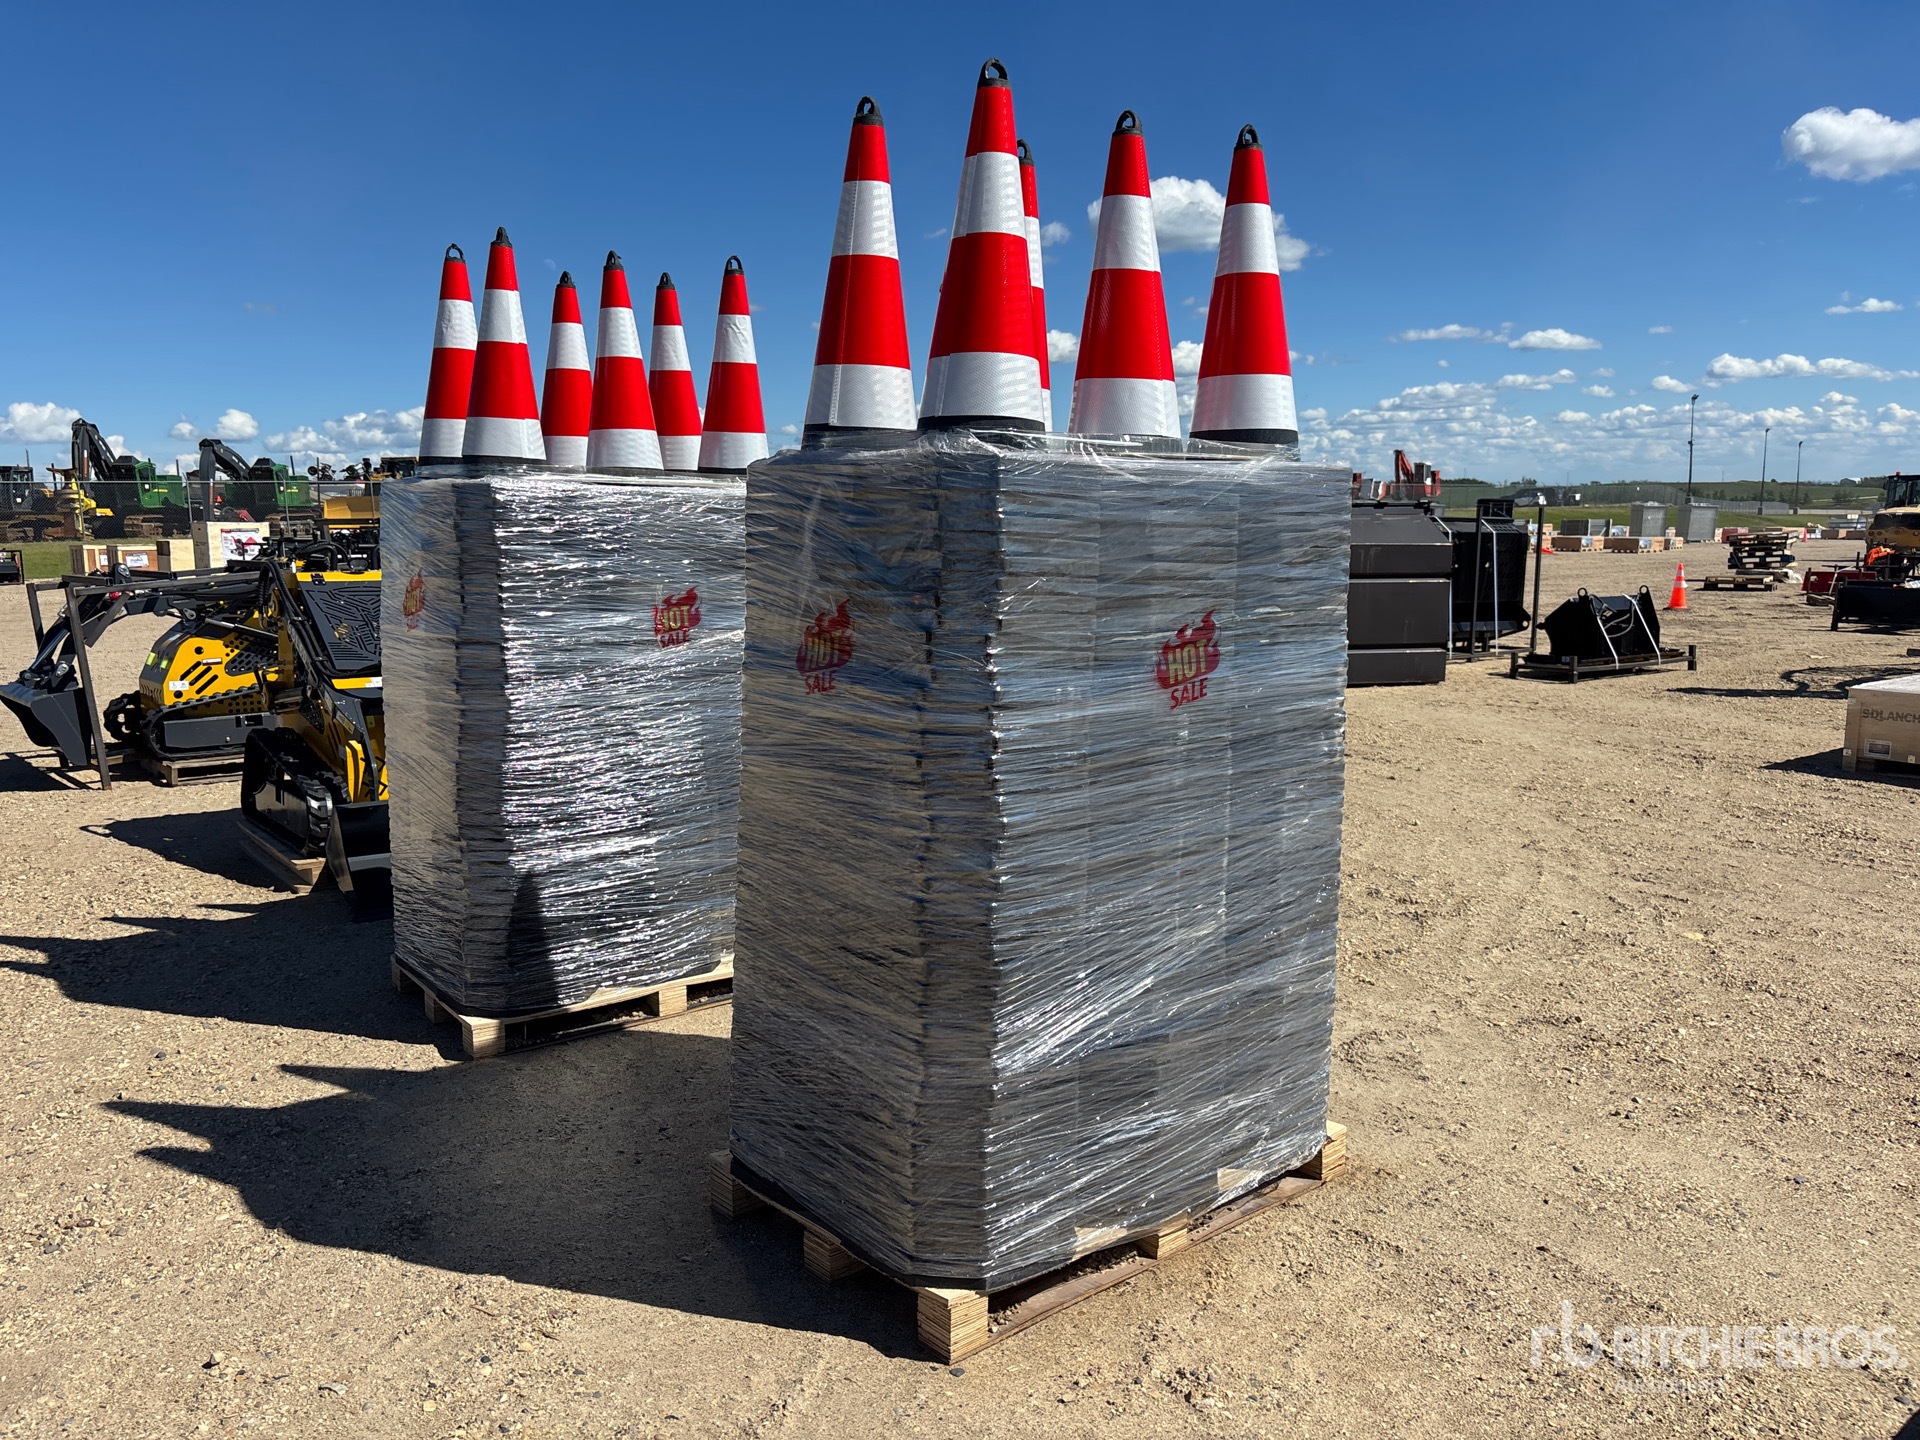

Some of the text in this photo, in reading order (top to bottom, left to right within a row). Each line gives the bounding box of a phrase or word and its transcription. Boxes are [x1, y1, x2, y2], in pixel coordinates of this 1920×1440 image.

[660, 629, 689, 648] SALE
[804, 629, 842, 671] HOT
[1167, 639, 1208, 685] HOT
[804, 669, 837, 696] SALE
[1169, 677, 1209, 710] SALE
